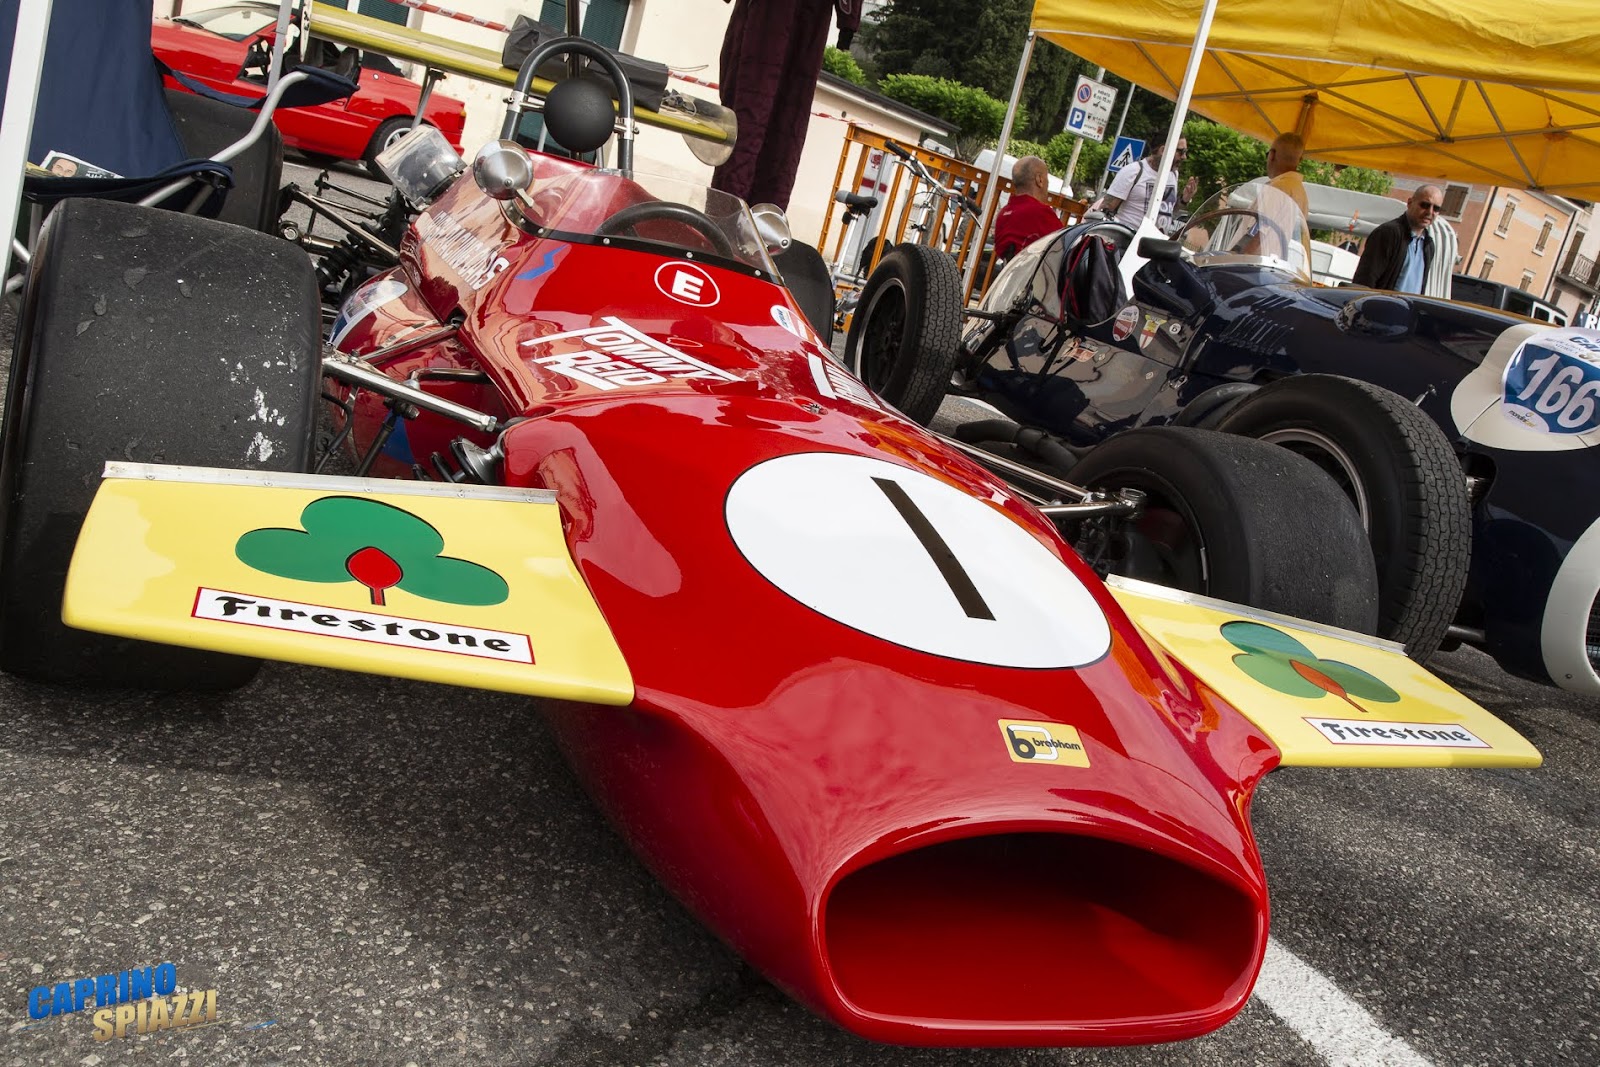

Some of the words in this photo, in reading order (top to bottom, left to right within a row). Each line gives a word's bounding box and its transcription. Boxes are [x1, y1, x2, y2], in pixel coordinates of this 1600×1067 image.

[457, 247, 510, 290] CARS
[671, 269, 704, 302] E
[521, 316, 746, 383] TOMMY
[532, 350, 668, 391] REID
[1516, 353, 1600, 428] 166
[870, 476, 997, 621] 1
[215, 596, 511, 652] Firestone
[1031, 737, 1082, 751] brabham
[1320, 722, 1472, 742] Firestone
